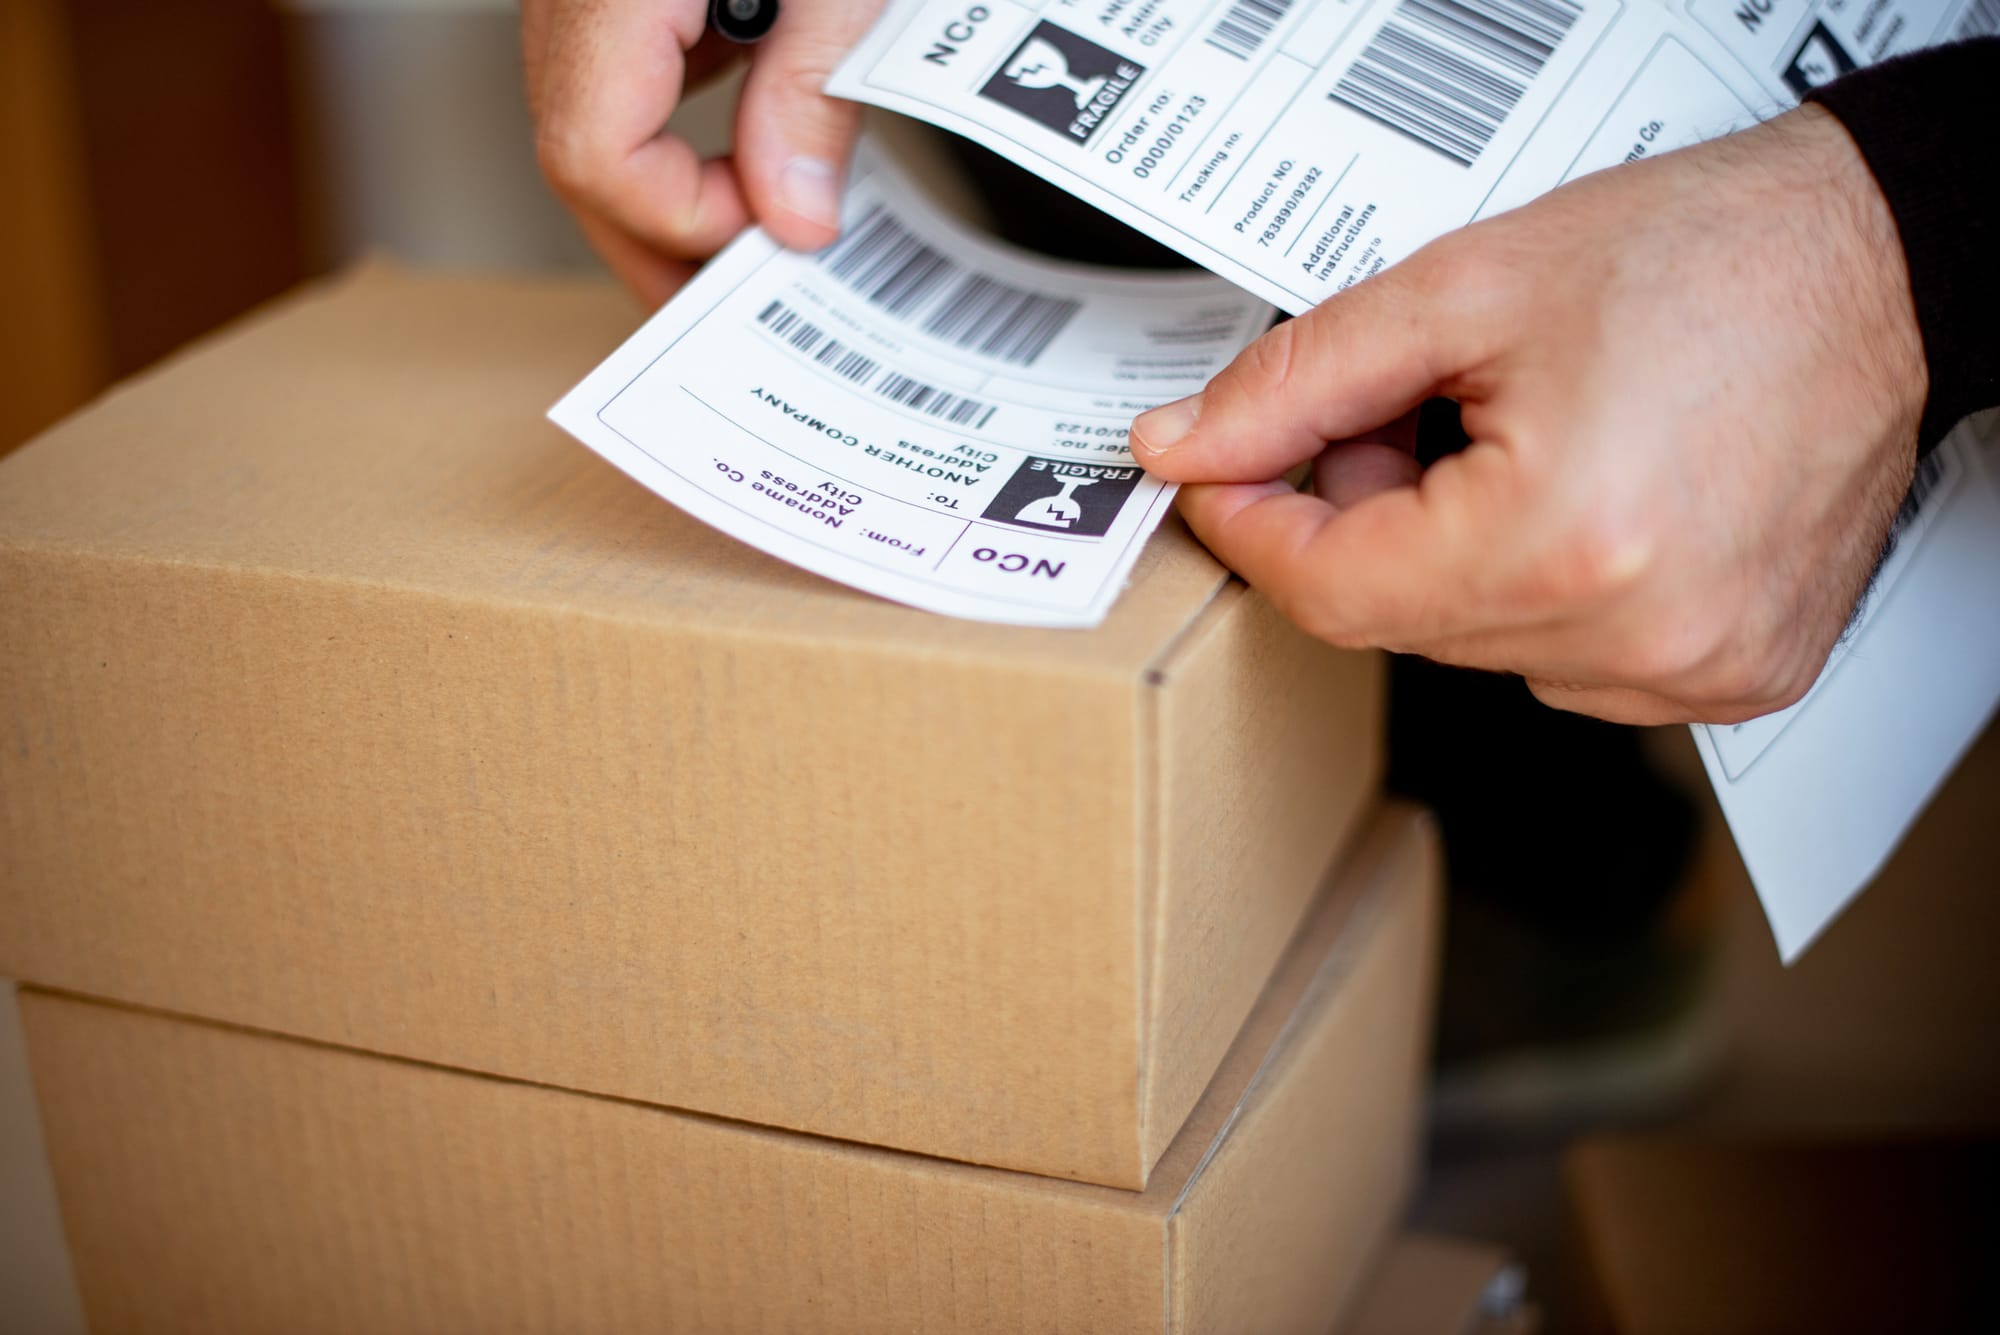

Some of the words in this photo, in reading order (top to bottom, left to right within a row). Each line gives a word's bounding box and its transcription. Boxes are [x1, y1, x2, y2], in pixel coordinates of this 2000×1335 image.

[923, 5, 990, 66] NCo
[1139, 16, 1174, 47] City
[1068, 62, 1139, 138] FRAGILE
[1105, 116, 1151, 165] Order
[1149, 89, 1174, 115] no:
[1132, 95, 1207, 179] 0000/0123
[1639, 120, 1665, 142] Co.
[1179, 149, 1228, 204] Tracking
[1223, 131, 1243, 150] no.
[1233, 181, 1278, 234] Product
[1272, 159, 1297, 181] NO.
[1257, 166, 1323, 248] 763890/9282
[1301, 204, 1355, 274] Additional
[1315, 203, 1377, 282] instructions
[1359, 246, 1377, 266] only
[1370, 237, 1382, 247] to
[750, 387, 859, 447] COMPANY
[1054, 422, 1130, 438] 0/0123
[897, 440, 991, 473] Address
[954, 444, 998, 463] City
[1052, 439, 1089, 449] no:
[1093, 444, 1131, 455] der
[713, 457, 745, 483] Co.
[864, 444, 980, 486] ANOTHER
[1030, 460, 1135, 480] FRAGILE
[751, 481, 843, 529] Noname
[760, 469, 855, 517] Address
[817, 481, 863, 506] City
[926, 492, 959, 510] To:
[858, 527, 926, 557] From:
[972, 547, 1066, 578] NCo
